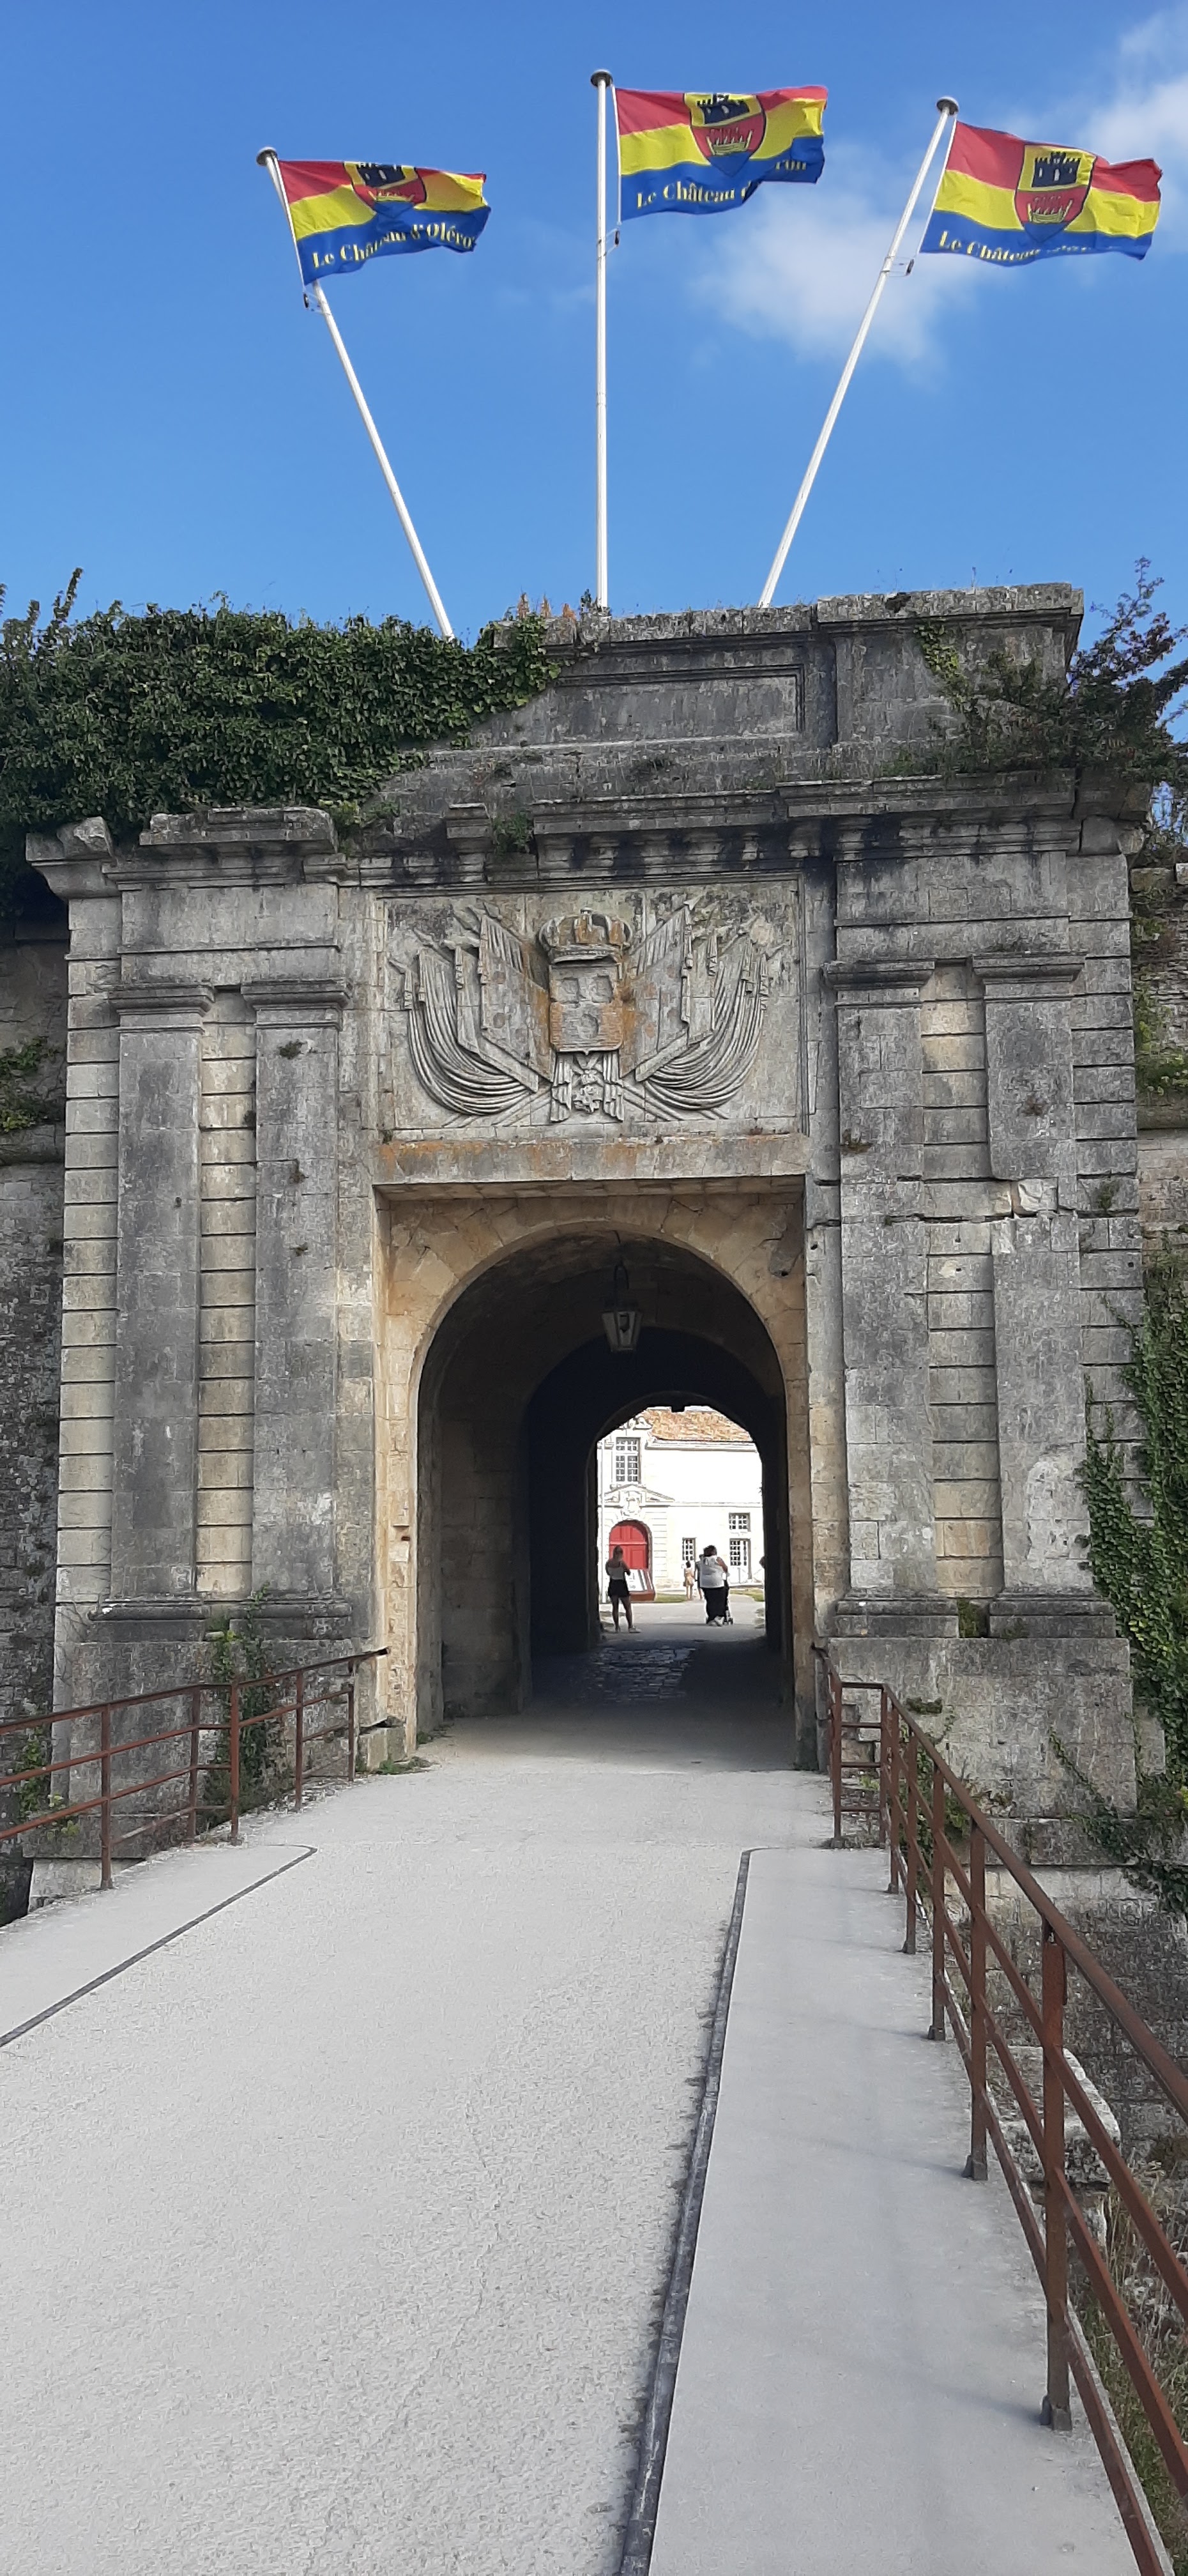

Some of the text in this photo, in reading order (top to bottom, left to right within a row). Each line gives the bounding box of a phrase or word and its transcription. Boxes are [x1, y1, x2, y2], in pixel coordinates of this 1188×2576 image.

[637, 192, 657, 208] Le
[313, 252, 335, 268] Le
[411, 222, 475, 249] d'Oléro
[940, 230, 962, 251] Le
